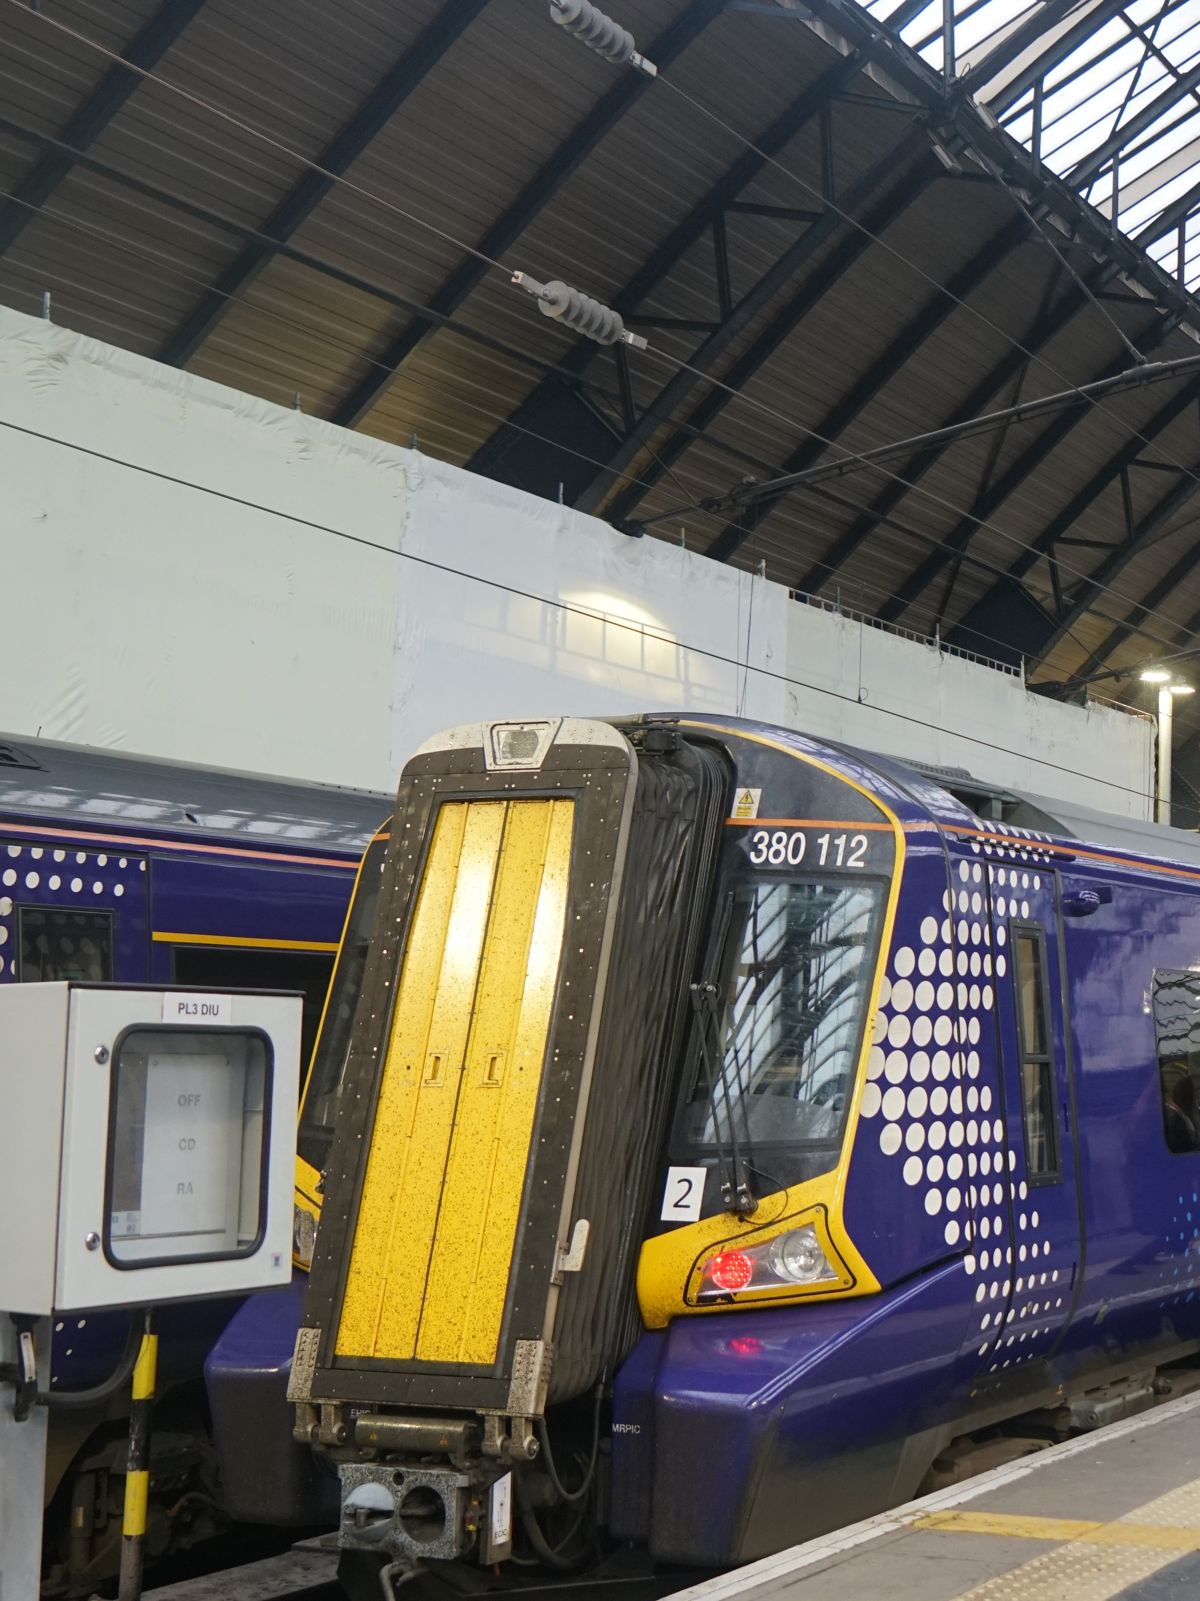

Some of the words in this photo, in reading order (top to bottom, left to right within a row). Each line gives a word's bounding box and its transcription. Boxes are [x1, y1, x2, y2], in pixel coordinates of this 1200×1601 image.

[750, 830, 807, 865] 380
[817, 833, 868, 868] 112
[178, 1002, 198, 1015] PL3
[200, 1003, 219, 1016] DIU
[178, 1094, 202, 1107] OFF
[178, 1138, 196, 1151] CD
[177, 1182, 194, 1195] RA
[673, 1178, 693, 1208] 2
